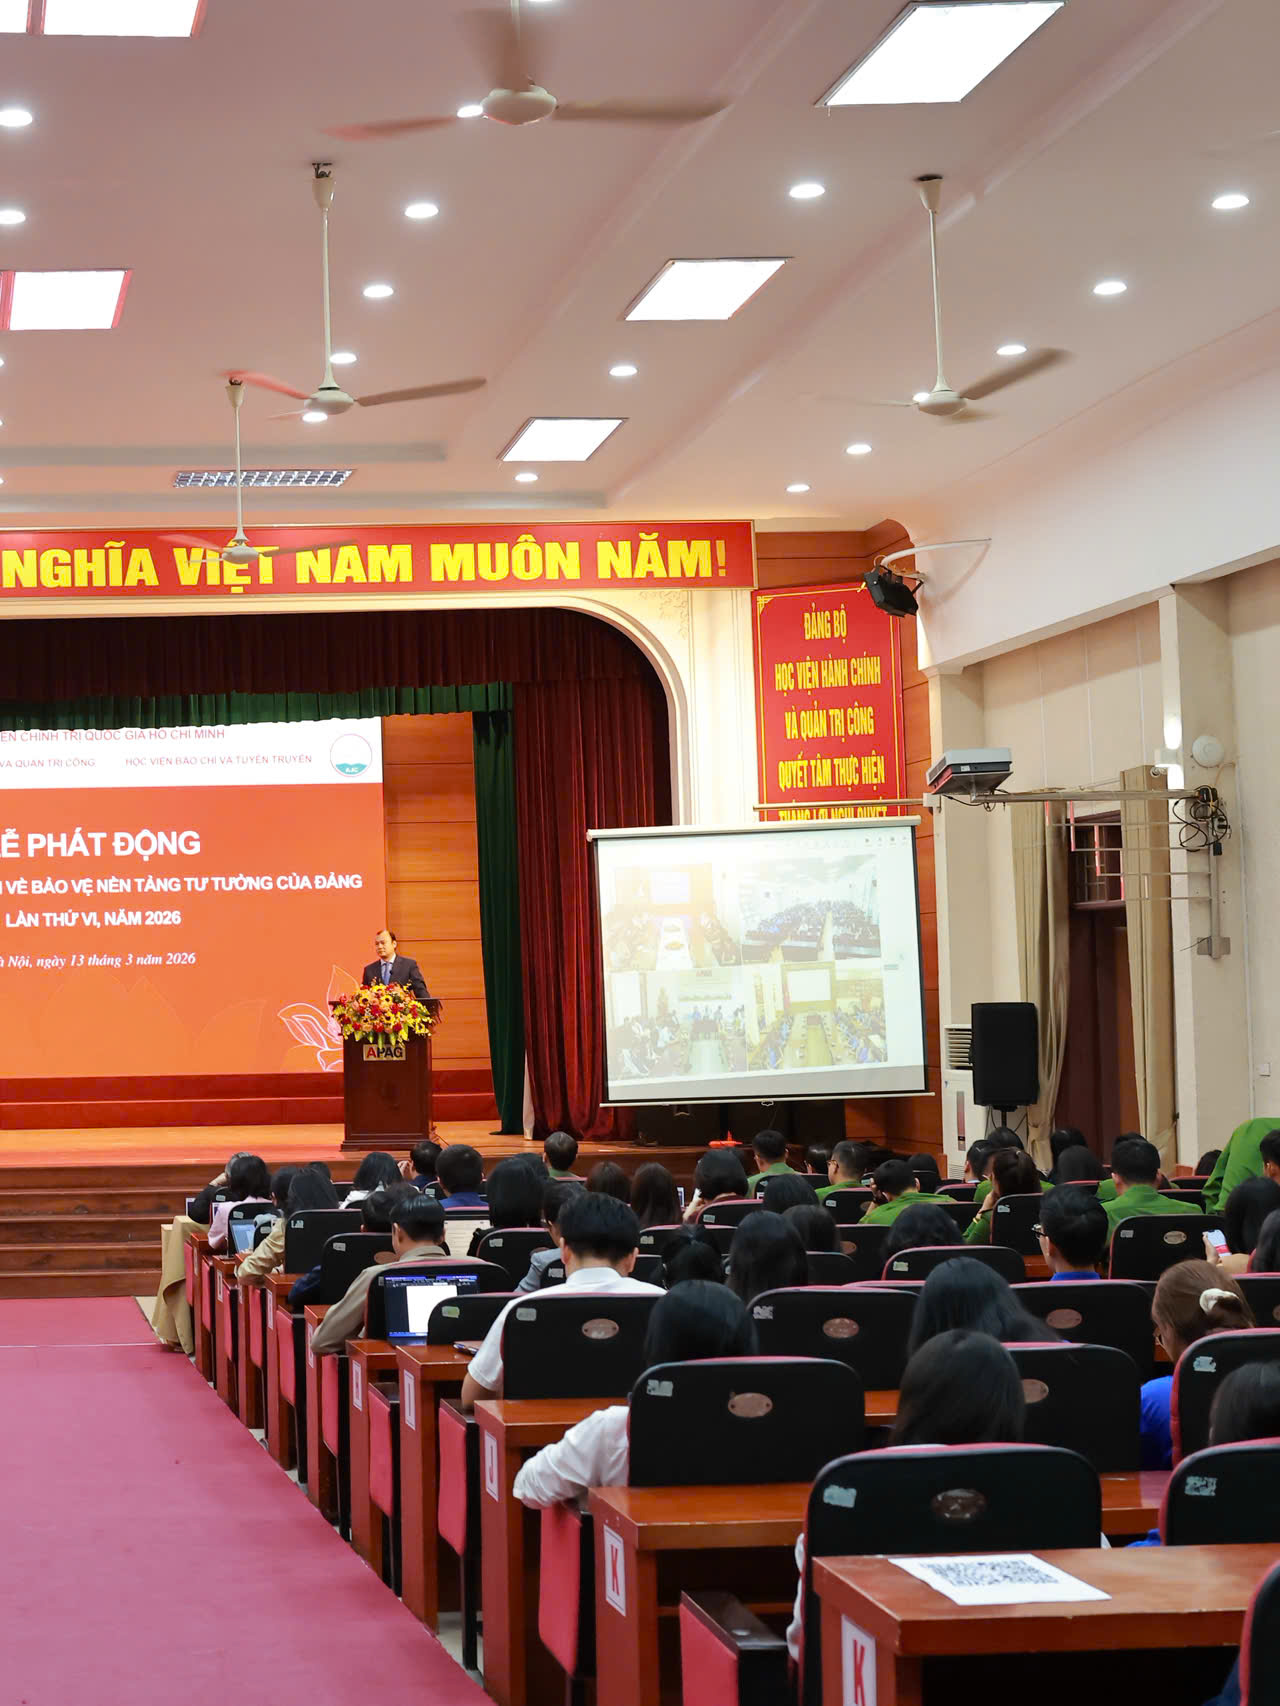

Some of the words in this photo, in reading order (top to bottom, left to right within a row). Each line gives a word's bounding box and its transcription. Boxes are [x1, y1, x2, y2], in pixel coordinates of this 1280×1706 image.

[2, 541, 159, 588] NGHĨA
[173, 540, 279, 593] VIỆT
[296, 545, 412, 583] NAM
[430, 534, 580, 581] MUÔN
[597, 533, 725, 579] NĂM!
[804, 603, 831, 640] ĐẢNG
[834, 604, 847, 643] BỘ
[775, 663, 794, 696] HỌC
[797, 656, 819, 694] VIỆN
[821, 654, 848, 688] HÀNH
[851, 652, 881, 685] CHÍNH
[125, 731, 146, 740] GIA
[195, 728, 225, 740] MINH
[785, 705, 799, 739] VÀ
[800, 701, 827, 741] QUẢN
[829, 709, 844, 742] TRỊ
[847, 702, 874, 735] CÔNG
[778, 751, 808, 792] QUYẾT
[810, 753, 832, 787] TÂM
[833, 754, 859, 791] THỰC
[861, 750, 884, 790] HIỆN
[28, 827, 107, 857] PHÁT
[112, 829, 200, 861] ĐỘNG
[71, 878, 93, 896] VỆ
[184, 877, 209, 891] TƯ
[42, 909, 79, 926] THỨ
[81, 912, 100, 928] VI,
[104, 909, 141, 925] NĂM
[145, 911, 181, 925] 2026
[8, 956, 32, 968] Nội,
[37, 955, 66, 968] ngày
[71, 955, 84, 966] 13
[88, 954, 121, 967] tháng
[126, 954, 133, 965] 3
[136, 955, 162, 964] năm
[166, 953, 195, 964] 2026
[367, 1047, 403, 1058] APAG
[611, 1543, 620, 1597] K
[853, 1639, 866, 1706] K
